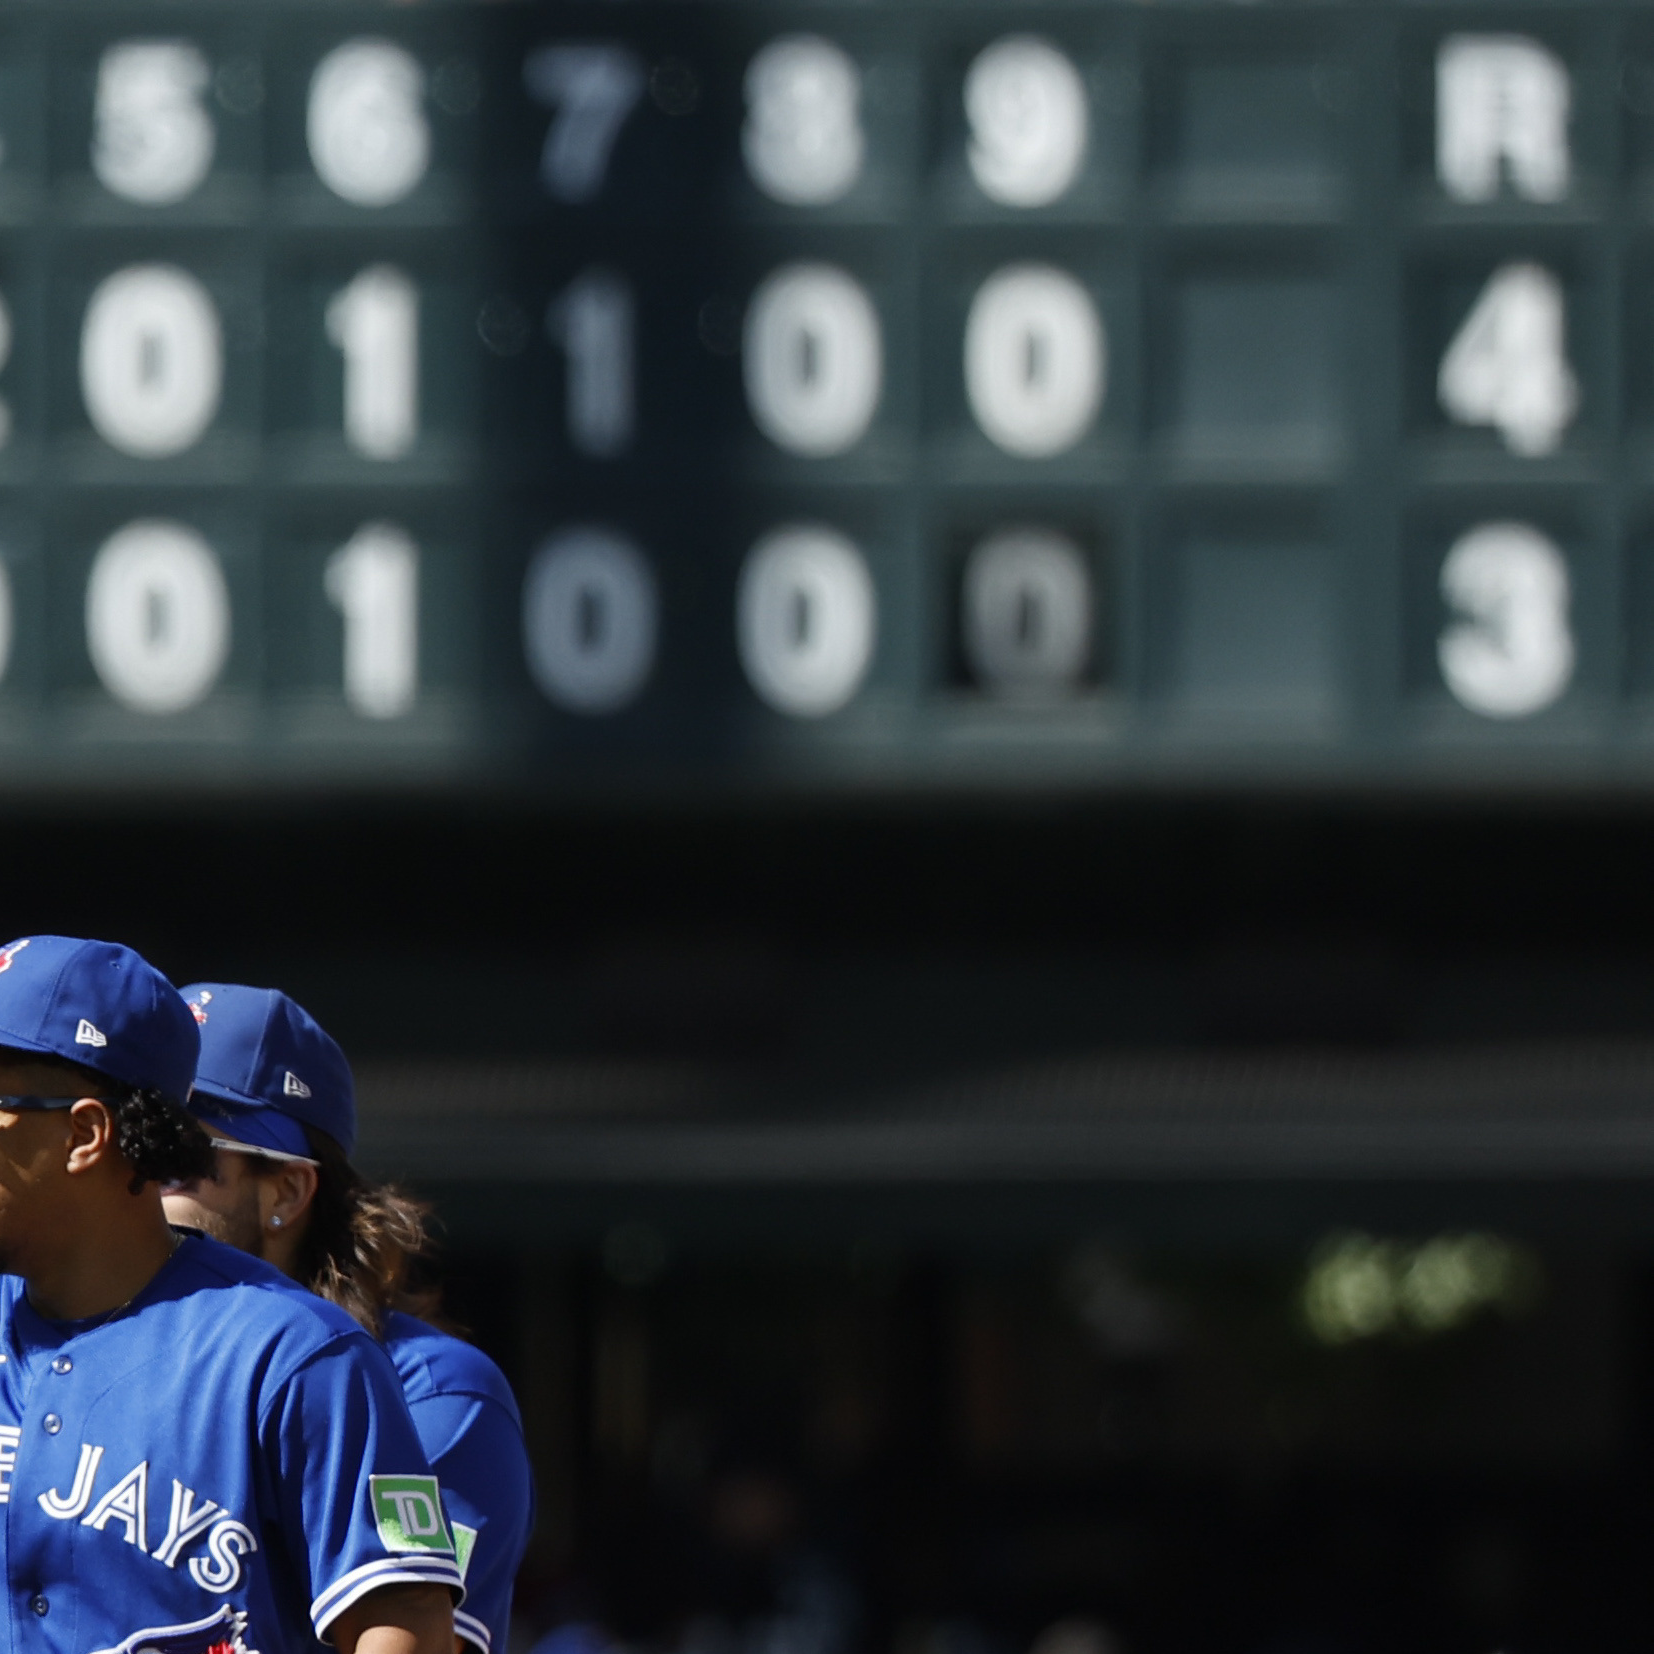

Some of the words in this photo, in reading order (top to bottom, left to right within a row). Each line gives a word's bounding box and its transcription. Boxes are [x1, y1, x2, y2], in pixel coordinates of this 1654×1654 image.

[93, 38, 216, 204] 5
[306, 35, 431, 207] 6
[522, 39, 640, 200] 7
[741, 33, 865, 207] 8
[964, 33, 1087, 207] 9
[1435, 33, 1571, 204] R
[77, 262, 223, 458] 0
[324, 262, 419, 460] 1
[546, 265, 635, 461] 1
[741, 259, 883, 460] 0
[964, 259, 1105, 460] 0
[1437, 258, 1579, 460] 4
[82, 518, 231, 716] 0
[324, 520, 419, 719] 1
[521, 523, 660, 718] 0
[735, 522, 877, 718] 0
[962, 520, 1095, 700] 0
[1437, 518, 1576, 720] 3
[37, 1443, 259, 1595] JAYS
[380, 1489, 440, 1537] TD
